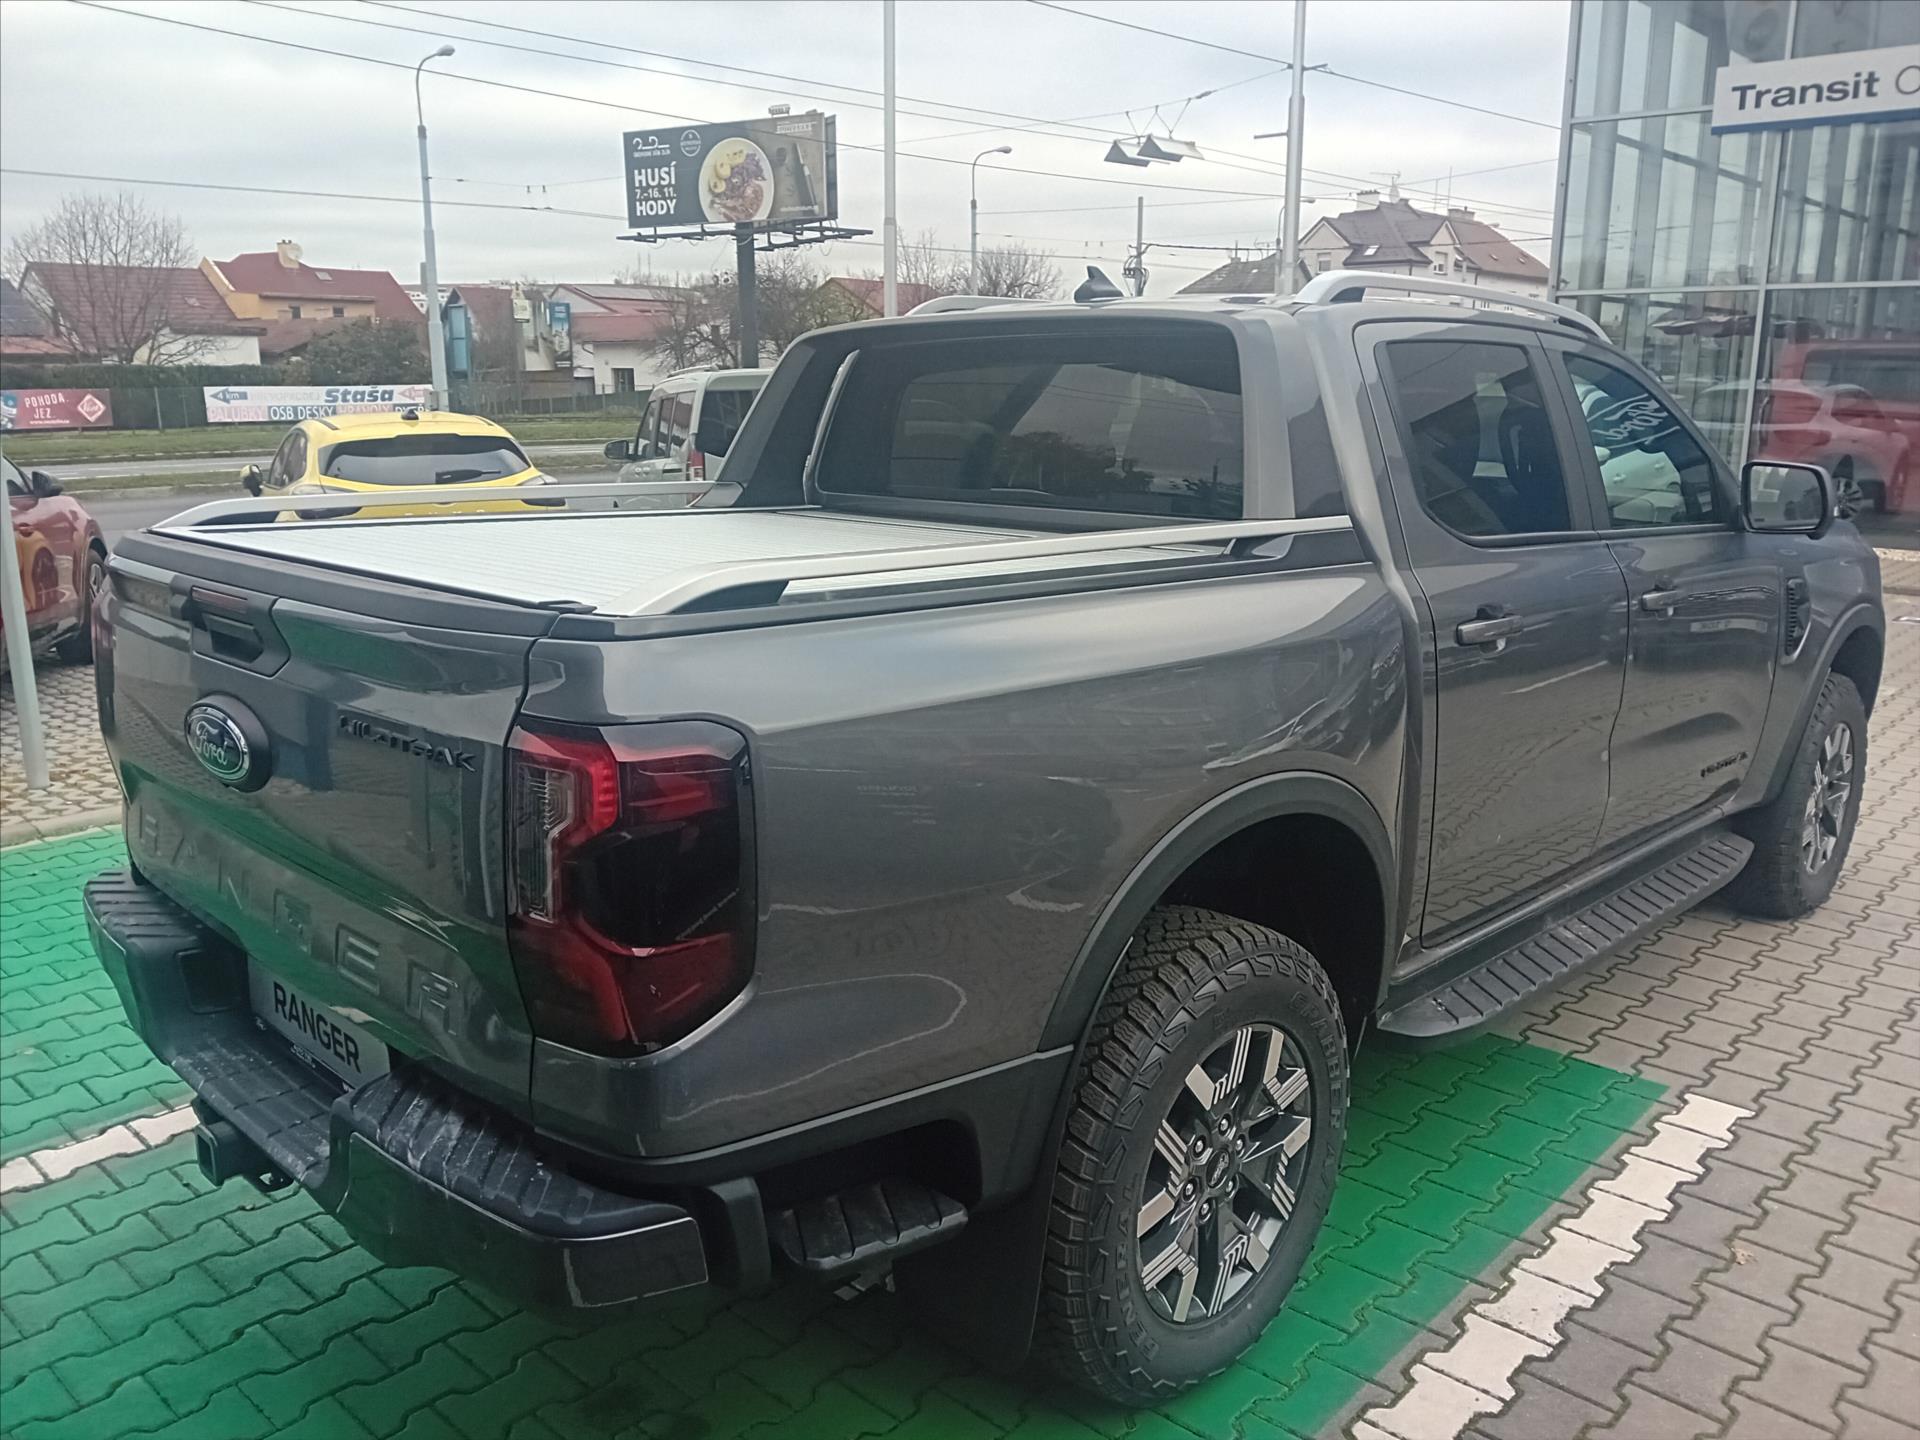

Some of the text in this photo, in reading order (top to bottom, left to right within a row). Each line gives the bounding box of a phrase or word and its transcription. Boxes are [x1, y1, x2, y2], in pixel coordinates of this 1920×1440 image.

[1731, 71, 1880, 110] Transit
[634, 161, 677, 187] HUSÍ
[636, 199, 677, 216] HODY
[225, 391, 240, 399] km
[325, 386, 394, 403] Staša
[270, 406, 294, 420] OSB
[297, 405, 334, 419] DESKY
[195, 720, 228, 766] Ford
[273, 980, 361, 1074] RANGER
